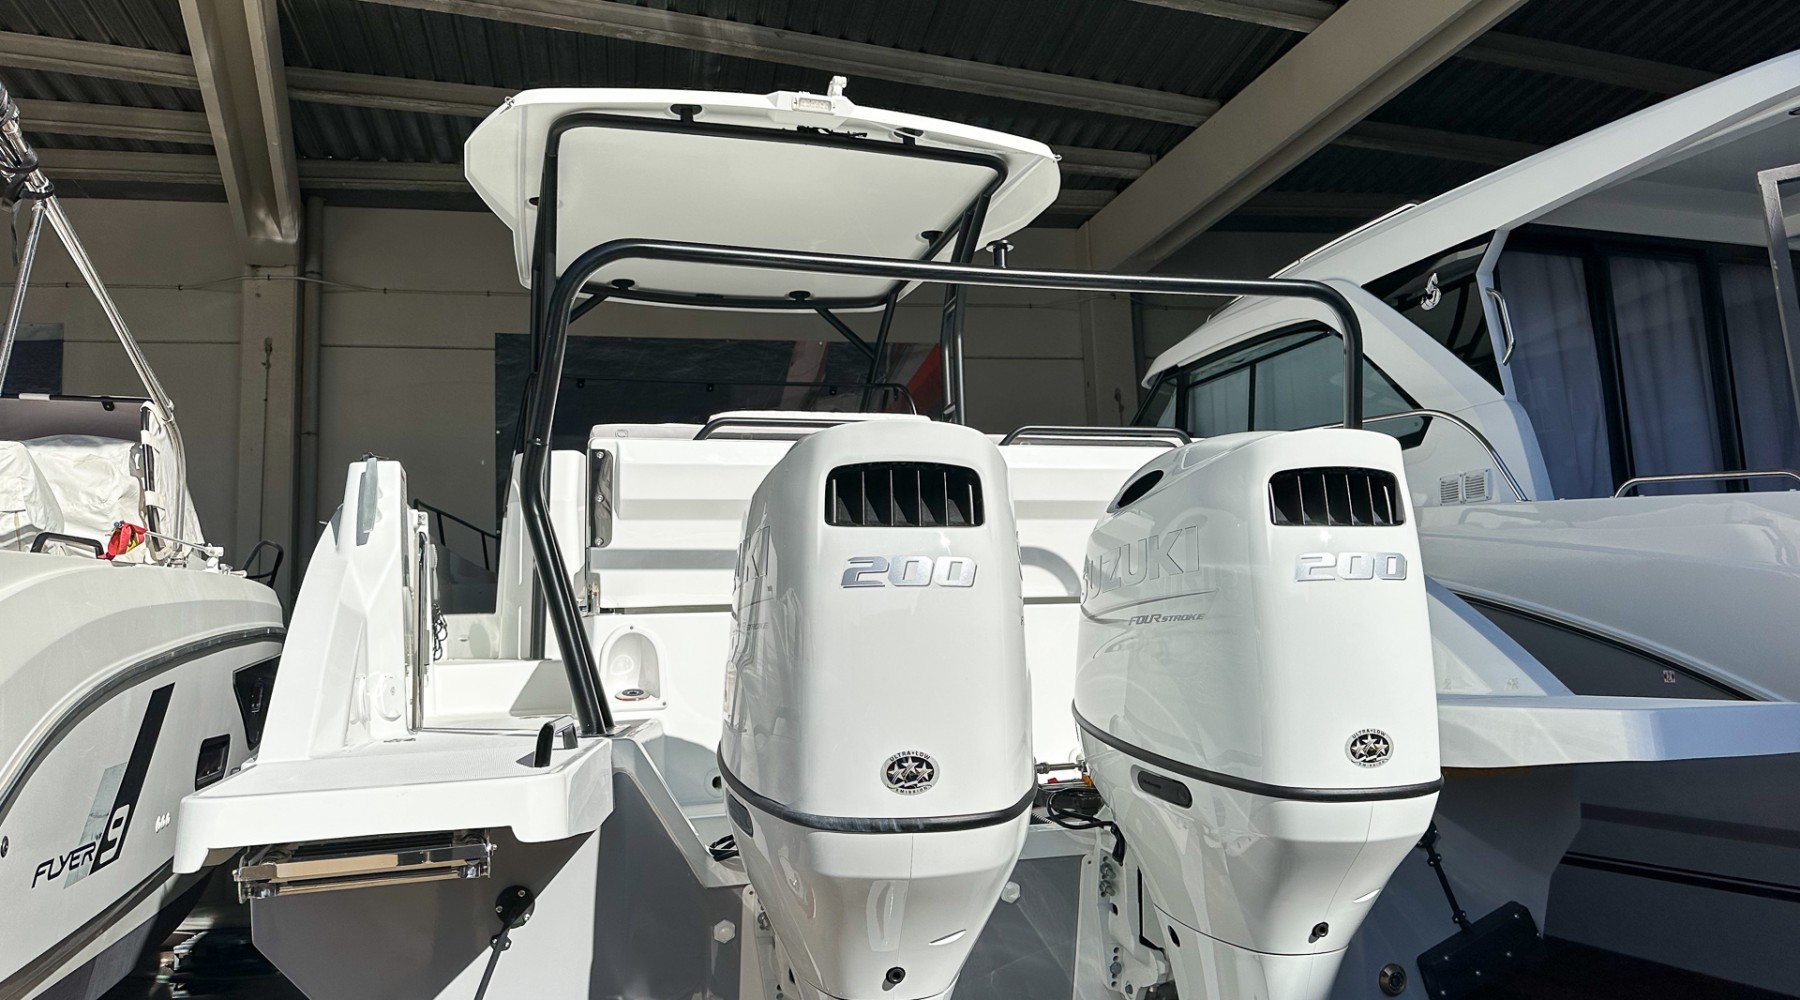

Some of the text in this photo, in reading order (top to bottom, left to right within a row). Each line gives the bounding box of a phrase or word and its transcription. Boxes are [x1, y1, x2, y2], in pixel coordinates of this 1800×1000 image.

[841, 556, 978, 588] 200
[1081, 525, 1200, 606] SUZUKI
[1295, 552, 1408, 582] 200
[31, 803, 130, 889] FLYER 9
